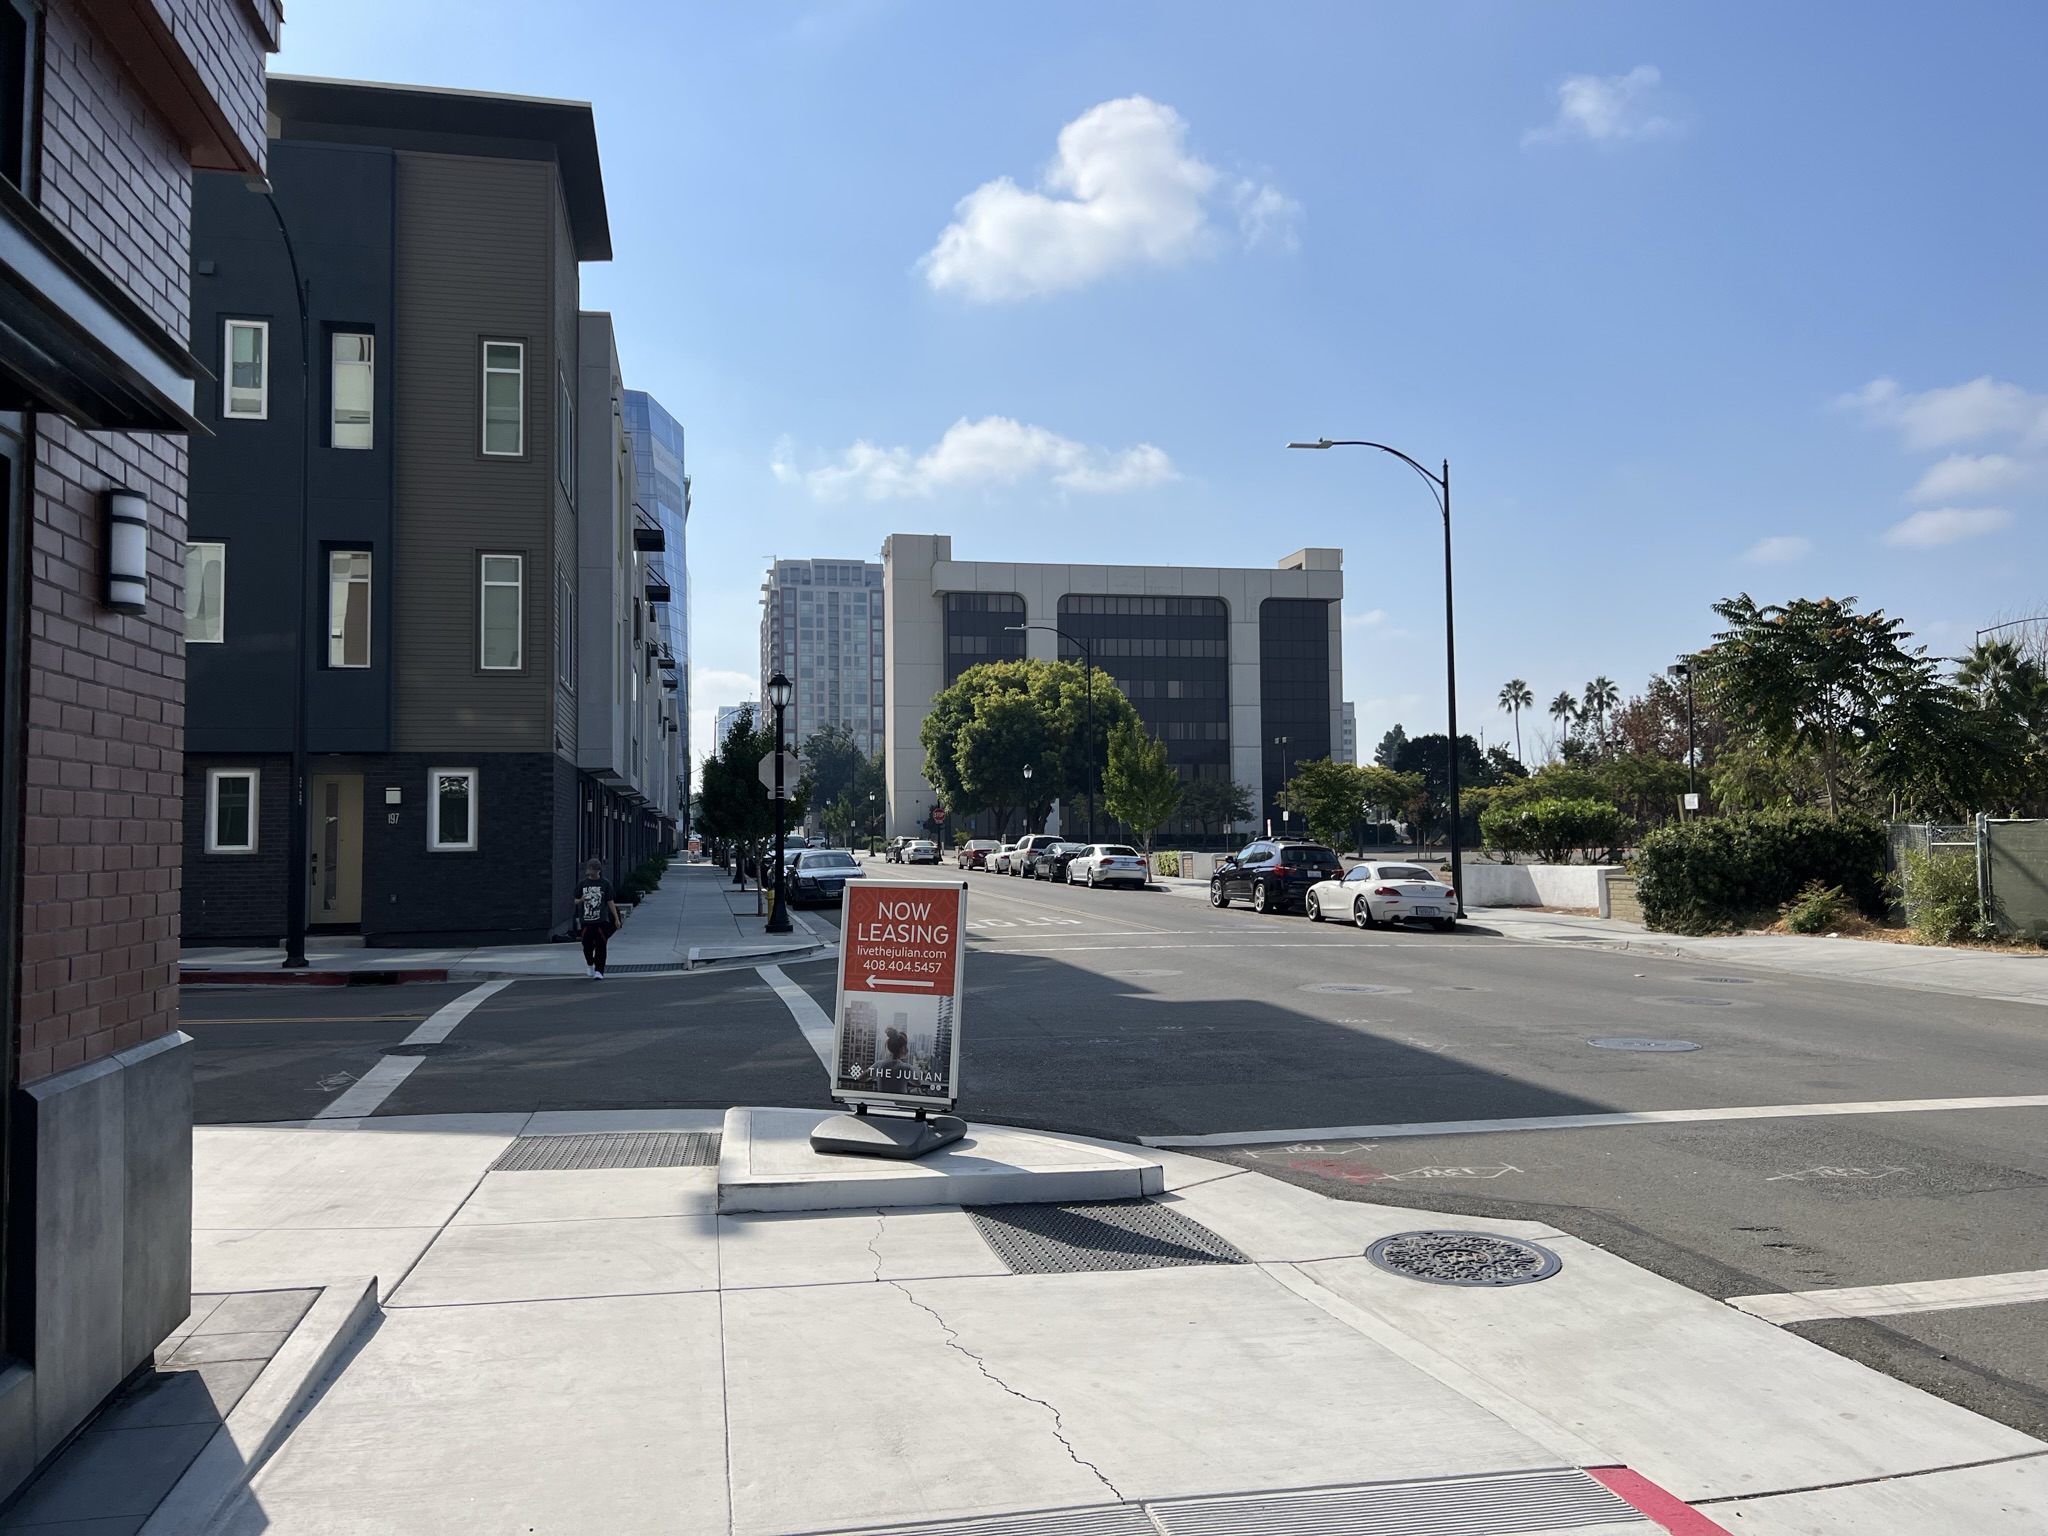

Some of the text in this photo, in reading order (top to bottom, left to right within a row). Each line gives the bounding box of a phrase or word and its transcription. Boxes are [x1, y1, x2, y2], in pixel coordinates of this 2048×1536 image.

[388, 812, 400, 825] 197
[878, 901, 932, 922] NOW
[857, 922, 949, 945] LEASING
[857, 945, 947, 959] livethejulian.com
[863, 960, 942, 974] 408.404.5457
[868, 1067, 943, 1082] THE JULIAN
